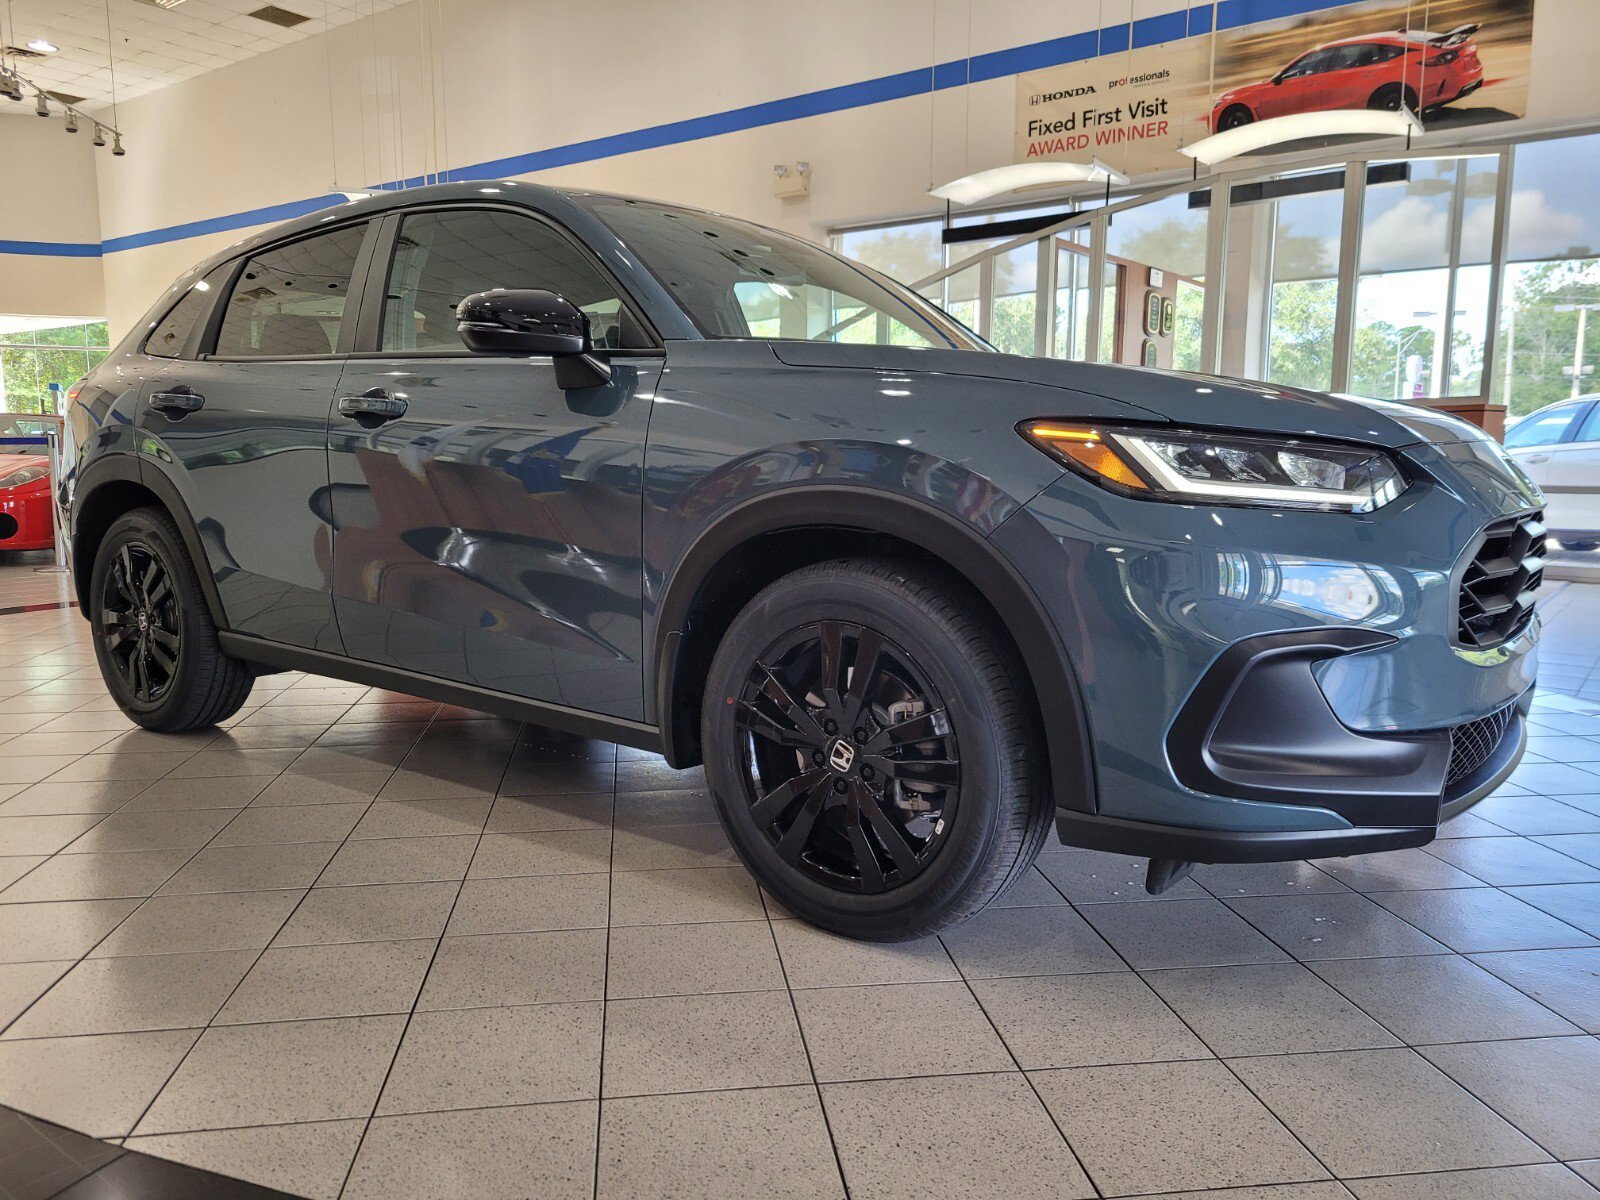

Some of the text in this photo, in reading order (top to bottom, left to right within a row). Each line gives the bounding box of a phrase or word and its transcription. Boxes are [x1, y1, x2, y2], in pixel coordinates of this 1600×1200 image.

[1042, 85, 1097, 103] HONDA
[1028, 98, 1168, 137] Fixed First Visit
[1027, 120, 1168, 158] AWARD WINNER
